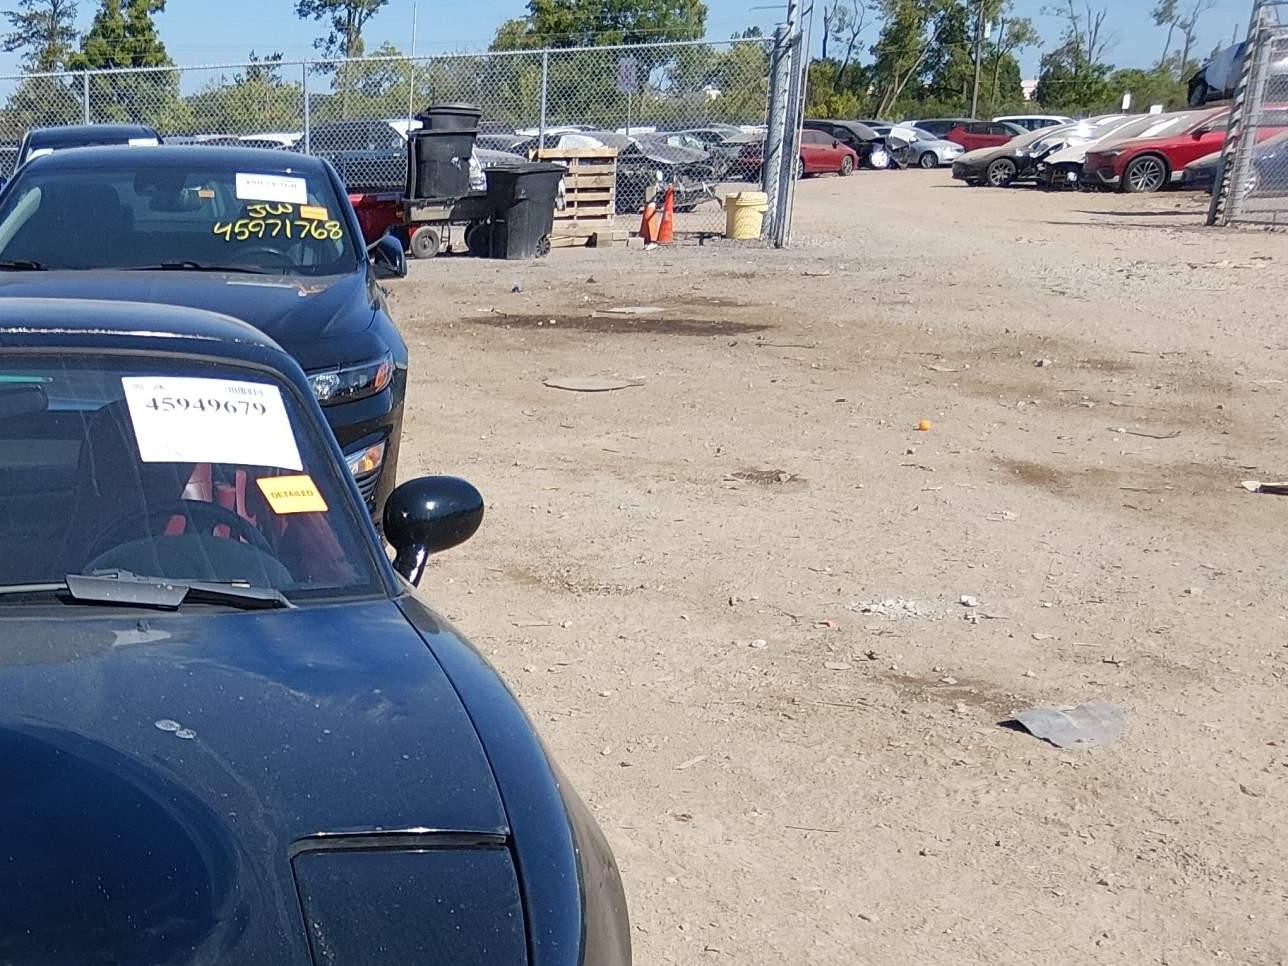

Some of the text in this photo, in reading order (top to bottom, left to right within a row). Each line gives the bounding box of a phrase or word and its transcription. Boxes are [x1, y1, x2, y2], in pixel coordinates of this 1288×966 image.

[213, 218, 343, 241] 45971768
[145, 396, 267, 416] 45949679
[270, 489, 314, 499] DETAILED
